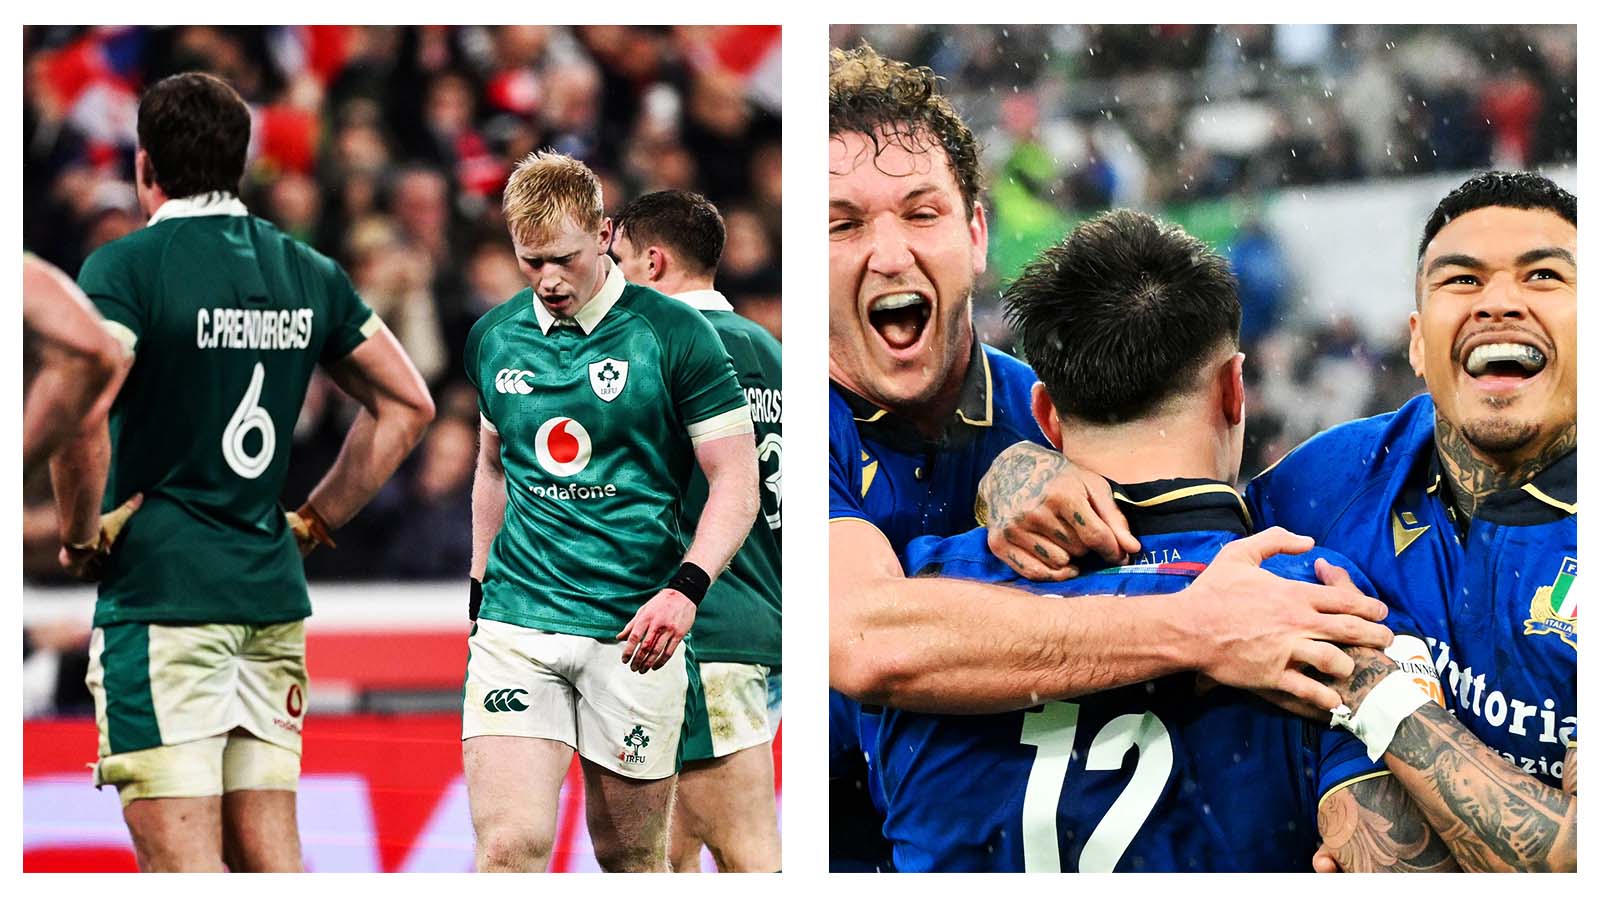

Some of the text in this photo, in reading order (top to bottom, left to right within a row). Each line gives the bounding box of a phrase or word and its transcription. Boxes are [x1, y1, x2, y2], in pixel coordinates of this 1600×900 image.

[600, 386, 618, 395] IRFU
[744, 387, 782, 424] GROS
[221, 361, 276, 480] 6
[1545, 618, 1573, 633] ITALIA
[626, 754, 646, 764] IRFU
[1020, 700, 1174, 873] 12
